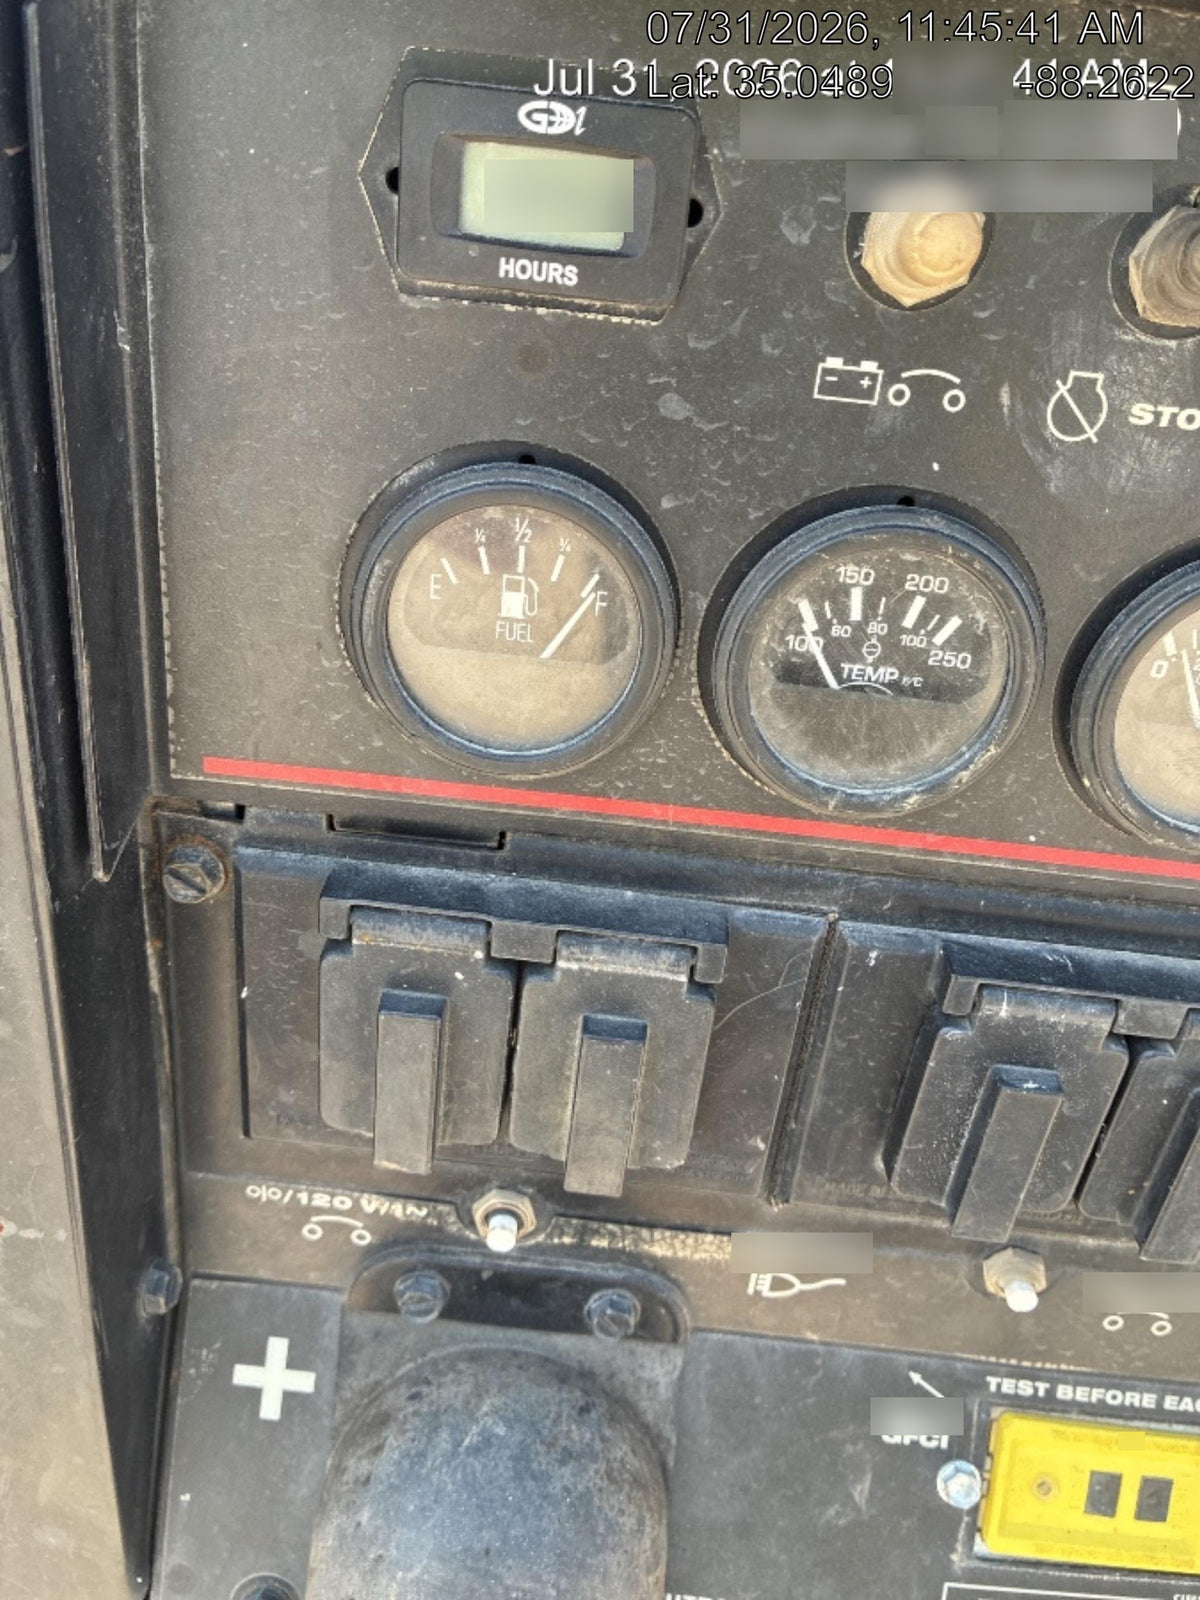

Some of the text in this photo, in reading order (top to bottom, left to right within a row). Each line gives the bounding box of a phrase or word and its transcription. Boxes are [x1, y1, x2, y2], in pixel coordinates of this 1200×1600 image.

[498, 256, 579, 287] HOURS
[429, 573, 441, 600] E
[835, 566, 876, 586] 150
[904, 573, 950, 594] 200
[594, 591, 609, 617] F
[495, 620, 534, 643] FUEL
[899, 633, 928, 648] 100
[784, 634, 825, 652] 100
[927, 650, 972, 670] 250
[840, 663, 900, 684] TEMP
[985, 1375, 1050, 1399] TEST
[1055, 1384, 1157, 1410] BEFORE
